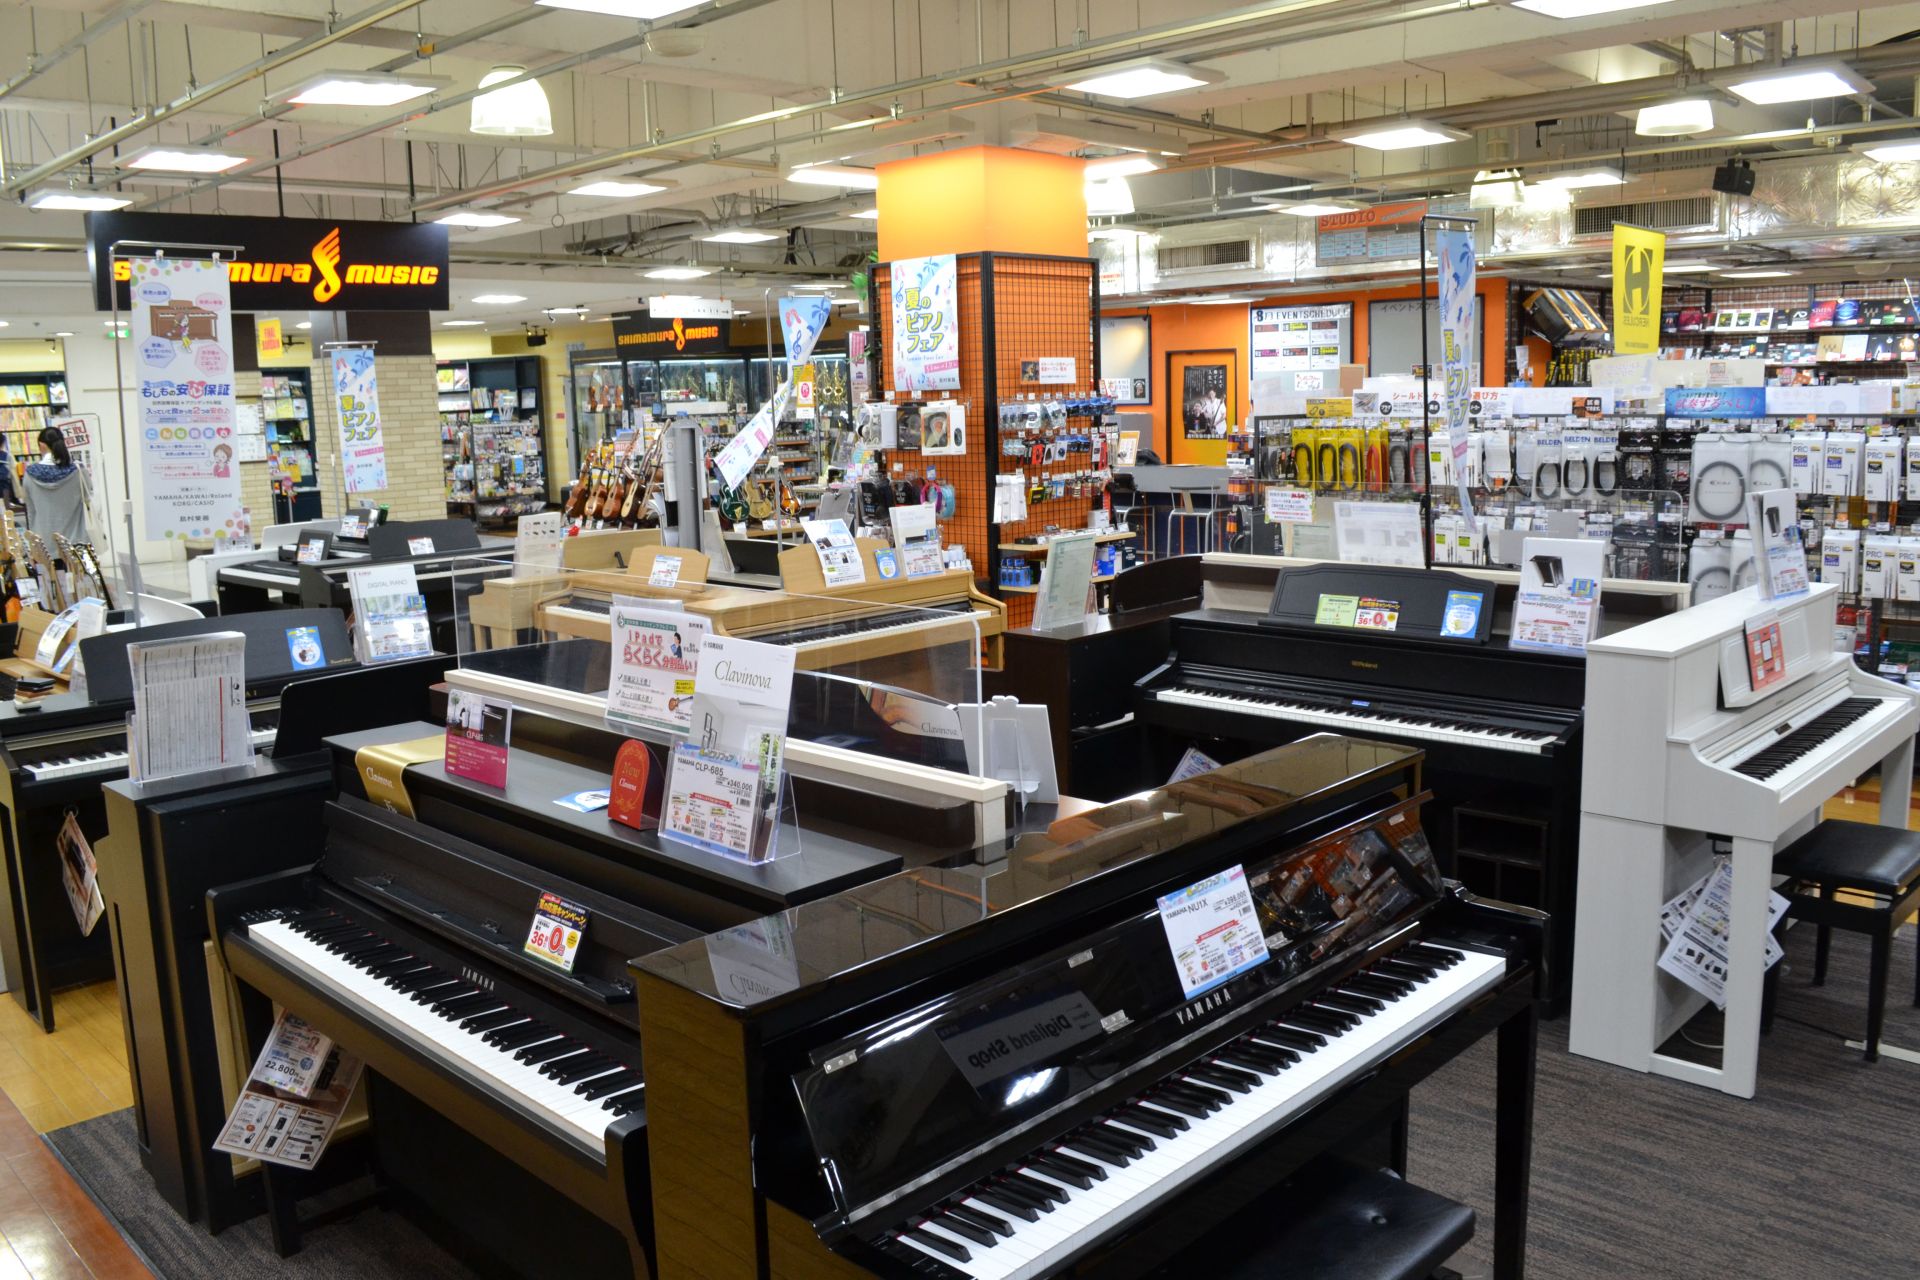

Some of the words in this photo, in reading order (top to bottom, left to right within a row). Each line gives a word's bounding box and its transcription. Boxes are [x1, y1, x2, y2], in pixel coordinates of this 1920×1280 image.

[1321, 210, 1376, 227] STUDIO
[905, 287, 931, 311] 夏の
[906, 312, 943, 333] ピアノ
[907, 333, 944, 353] フェア
[342, 412, 376, 428] ピアノ
[344, 427, 378, 442] フェア
[367, 580, 388, 589] DIGITAL
[389, 579, 408, 587] PIANO
[714, 659, 773, 689] Clavinova
[677, 757, 695, 766] YAMAHA
[694, 762, 724, 776] CLP-685
[1165, 907, 1188, 919] YAMAHA
[1176, 988, 1232, 1025] YAMAHA
